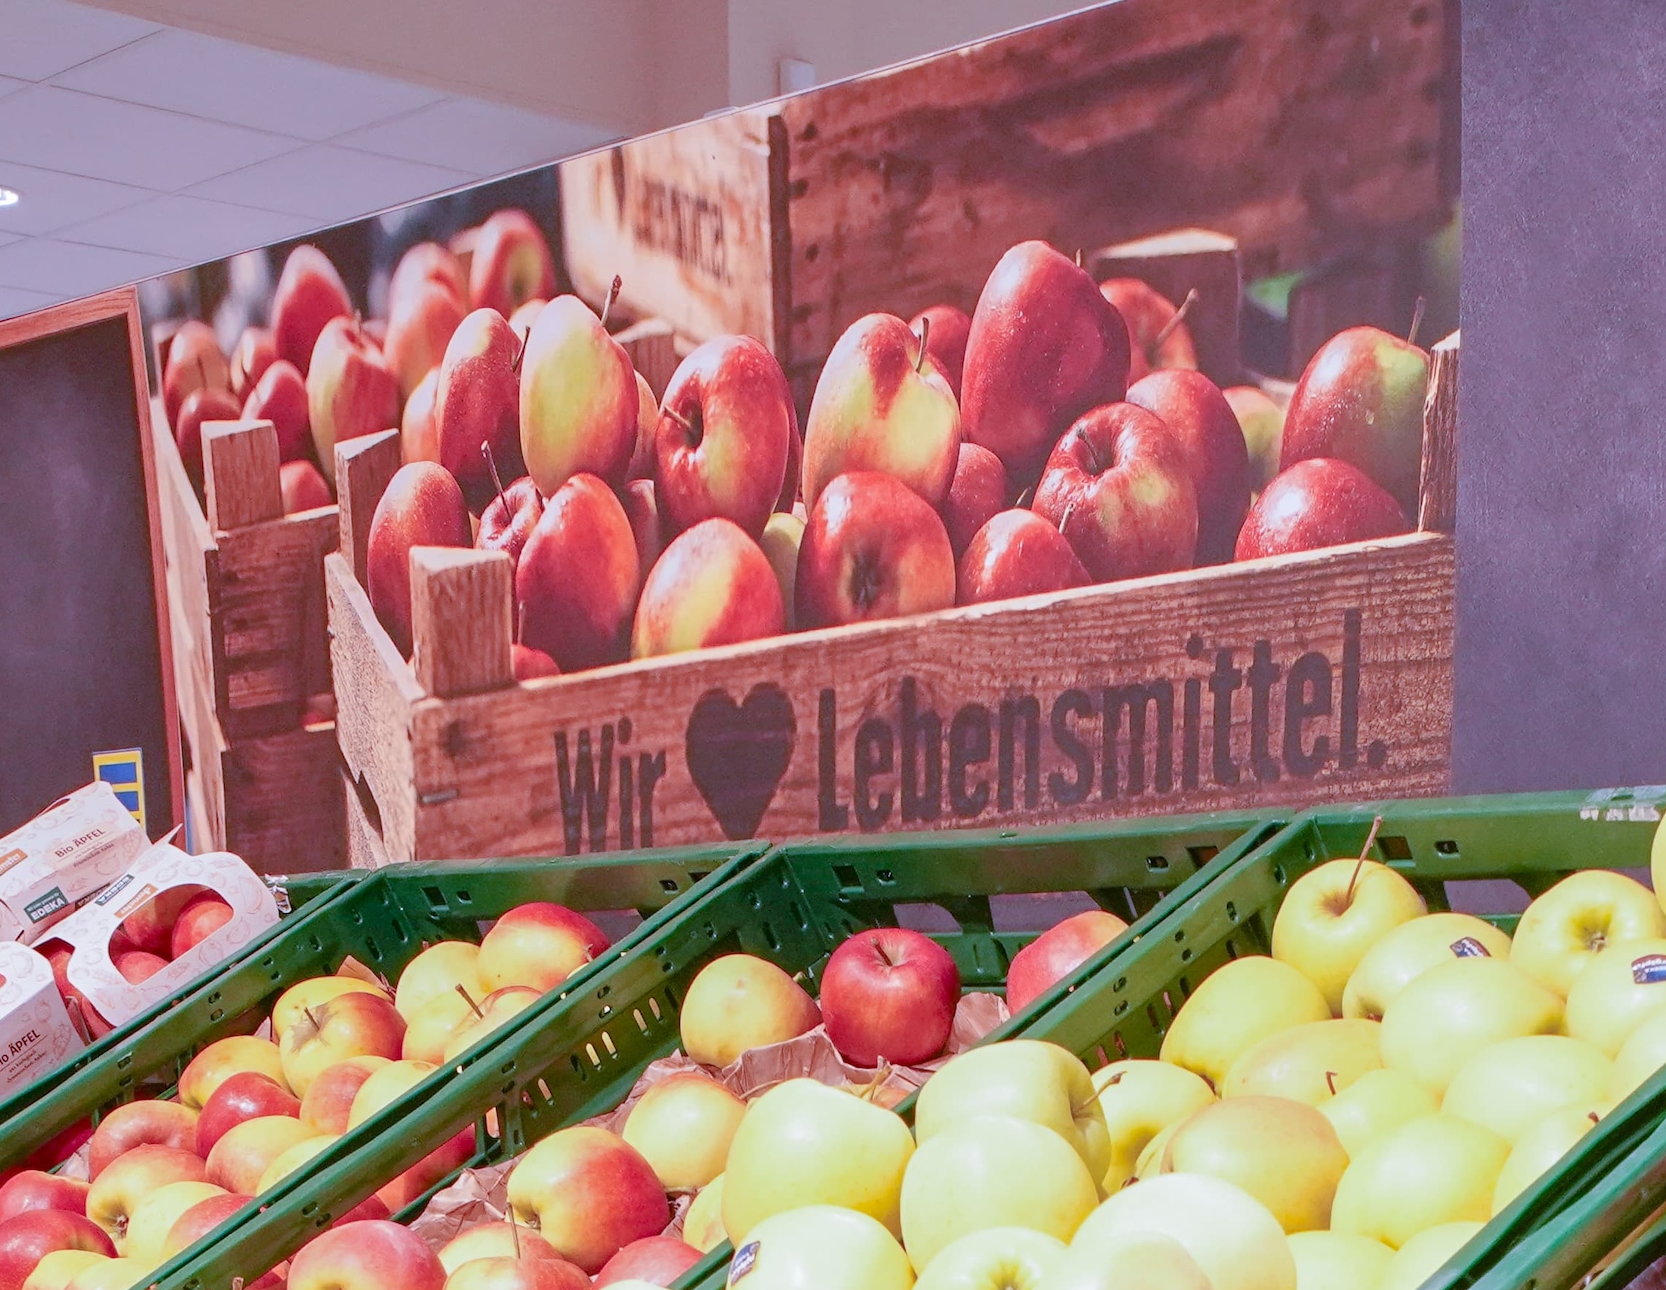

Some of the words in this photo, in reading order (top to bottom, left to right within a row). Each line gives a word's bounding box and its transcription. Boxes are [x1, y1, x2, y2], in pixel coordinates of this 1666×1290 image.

[554, 717, 666, 856] Wir
[816, 608, 1387, 832] Lebensmittel.
[55, 846, 73, 858] Bio
[73, 828, 105, 848] ÄPFEL
[30, 897, 65, 920] EDEKA
[9, 1029, 41, 1057] ÄPFEL
